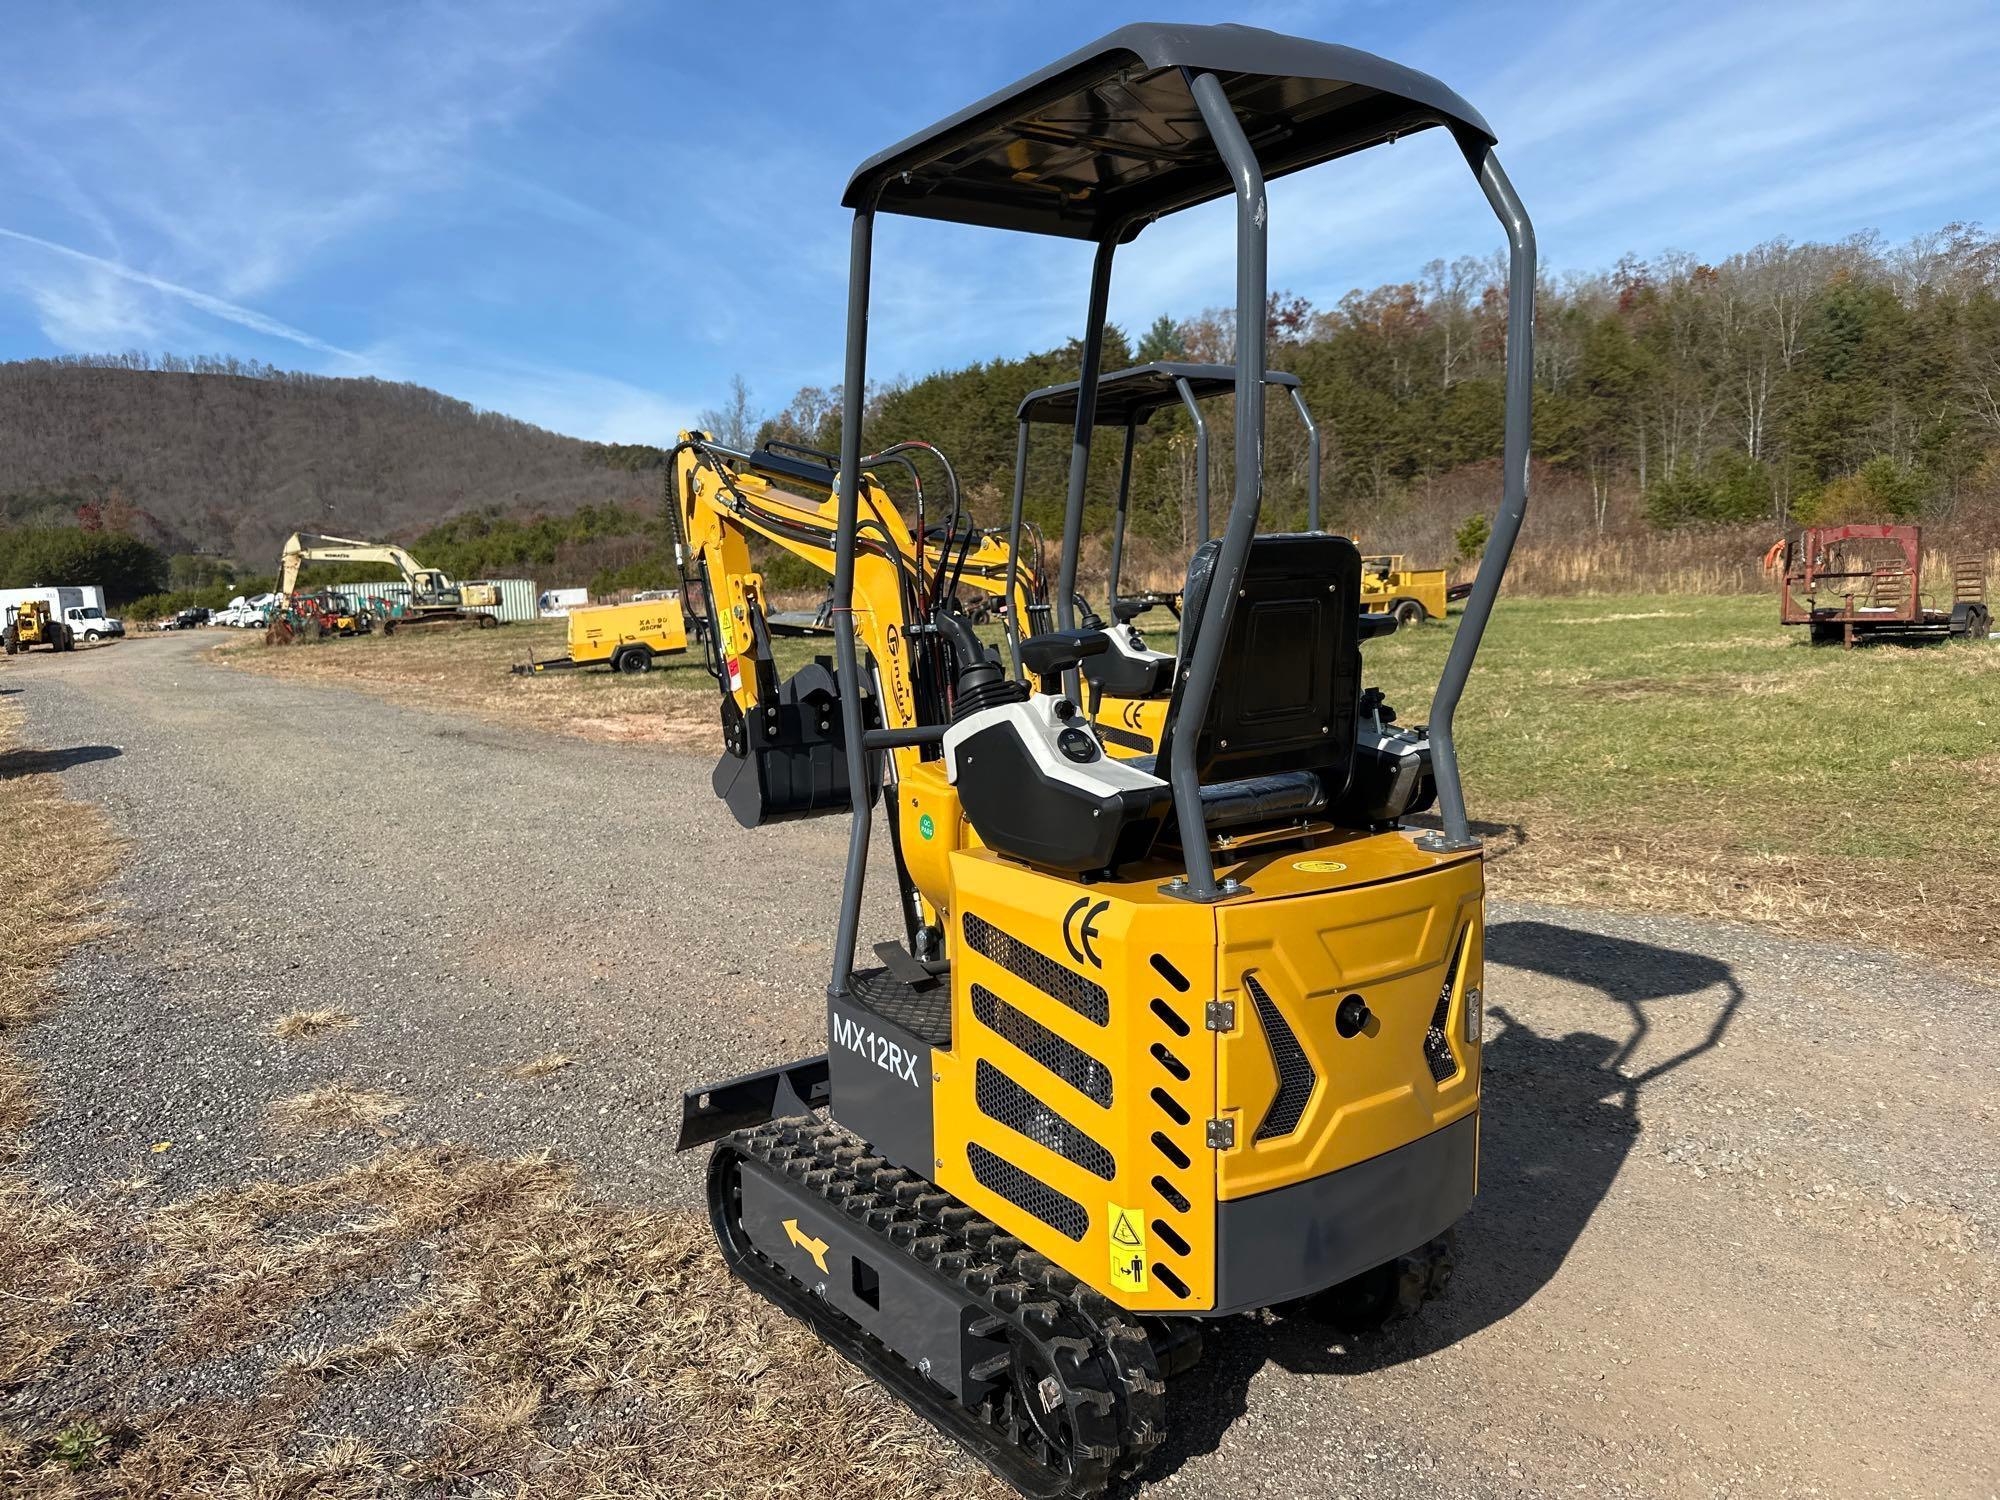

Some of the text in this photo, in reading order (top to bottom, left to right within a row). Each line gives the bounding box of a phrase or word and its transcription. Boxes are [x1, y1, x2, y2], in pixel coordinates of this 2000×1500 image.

[1123, 701, 1145, 729] CE
[1063, 896, 1110, 970] CE
[833, 1012, 919, 1088] MX12RX
